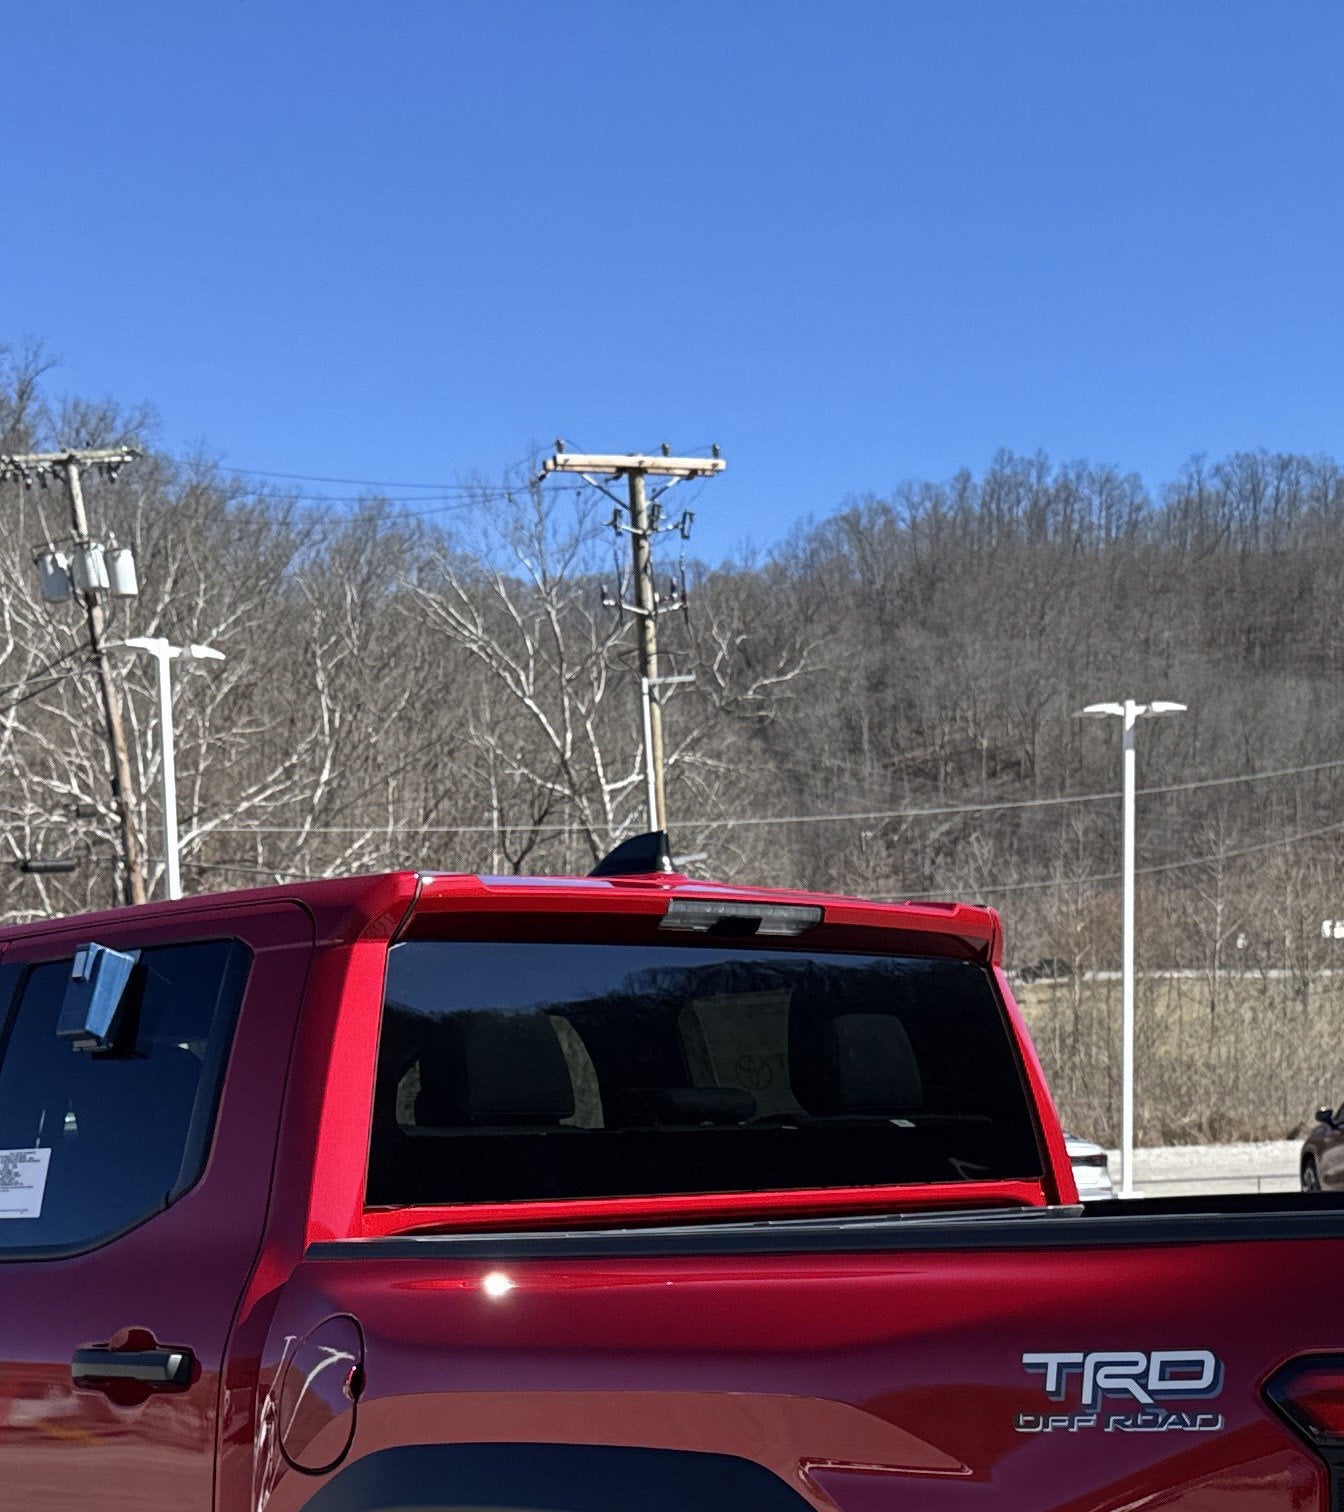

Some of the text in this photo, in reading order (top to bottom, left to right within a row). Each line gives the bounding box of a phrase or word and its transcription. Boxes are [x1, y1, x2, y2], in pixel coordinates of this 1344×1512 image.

[1022, 1350, 1225, 1412] TRD
[1015, 1413, 1225, 1433] OFF ROAD
